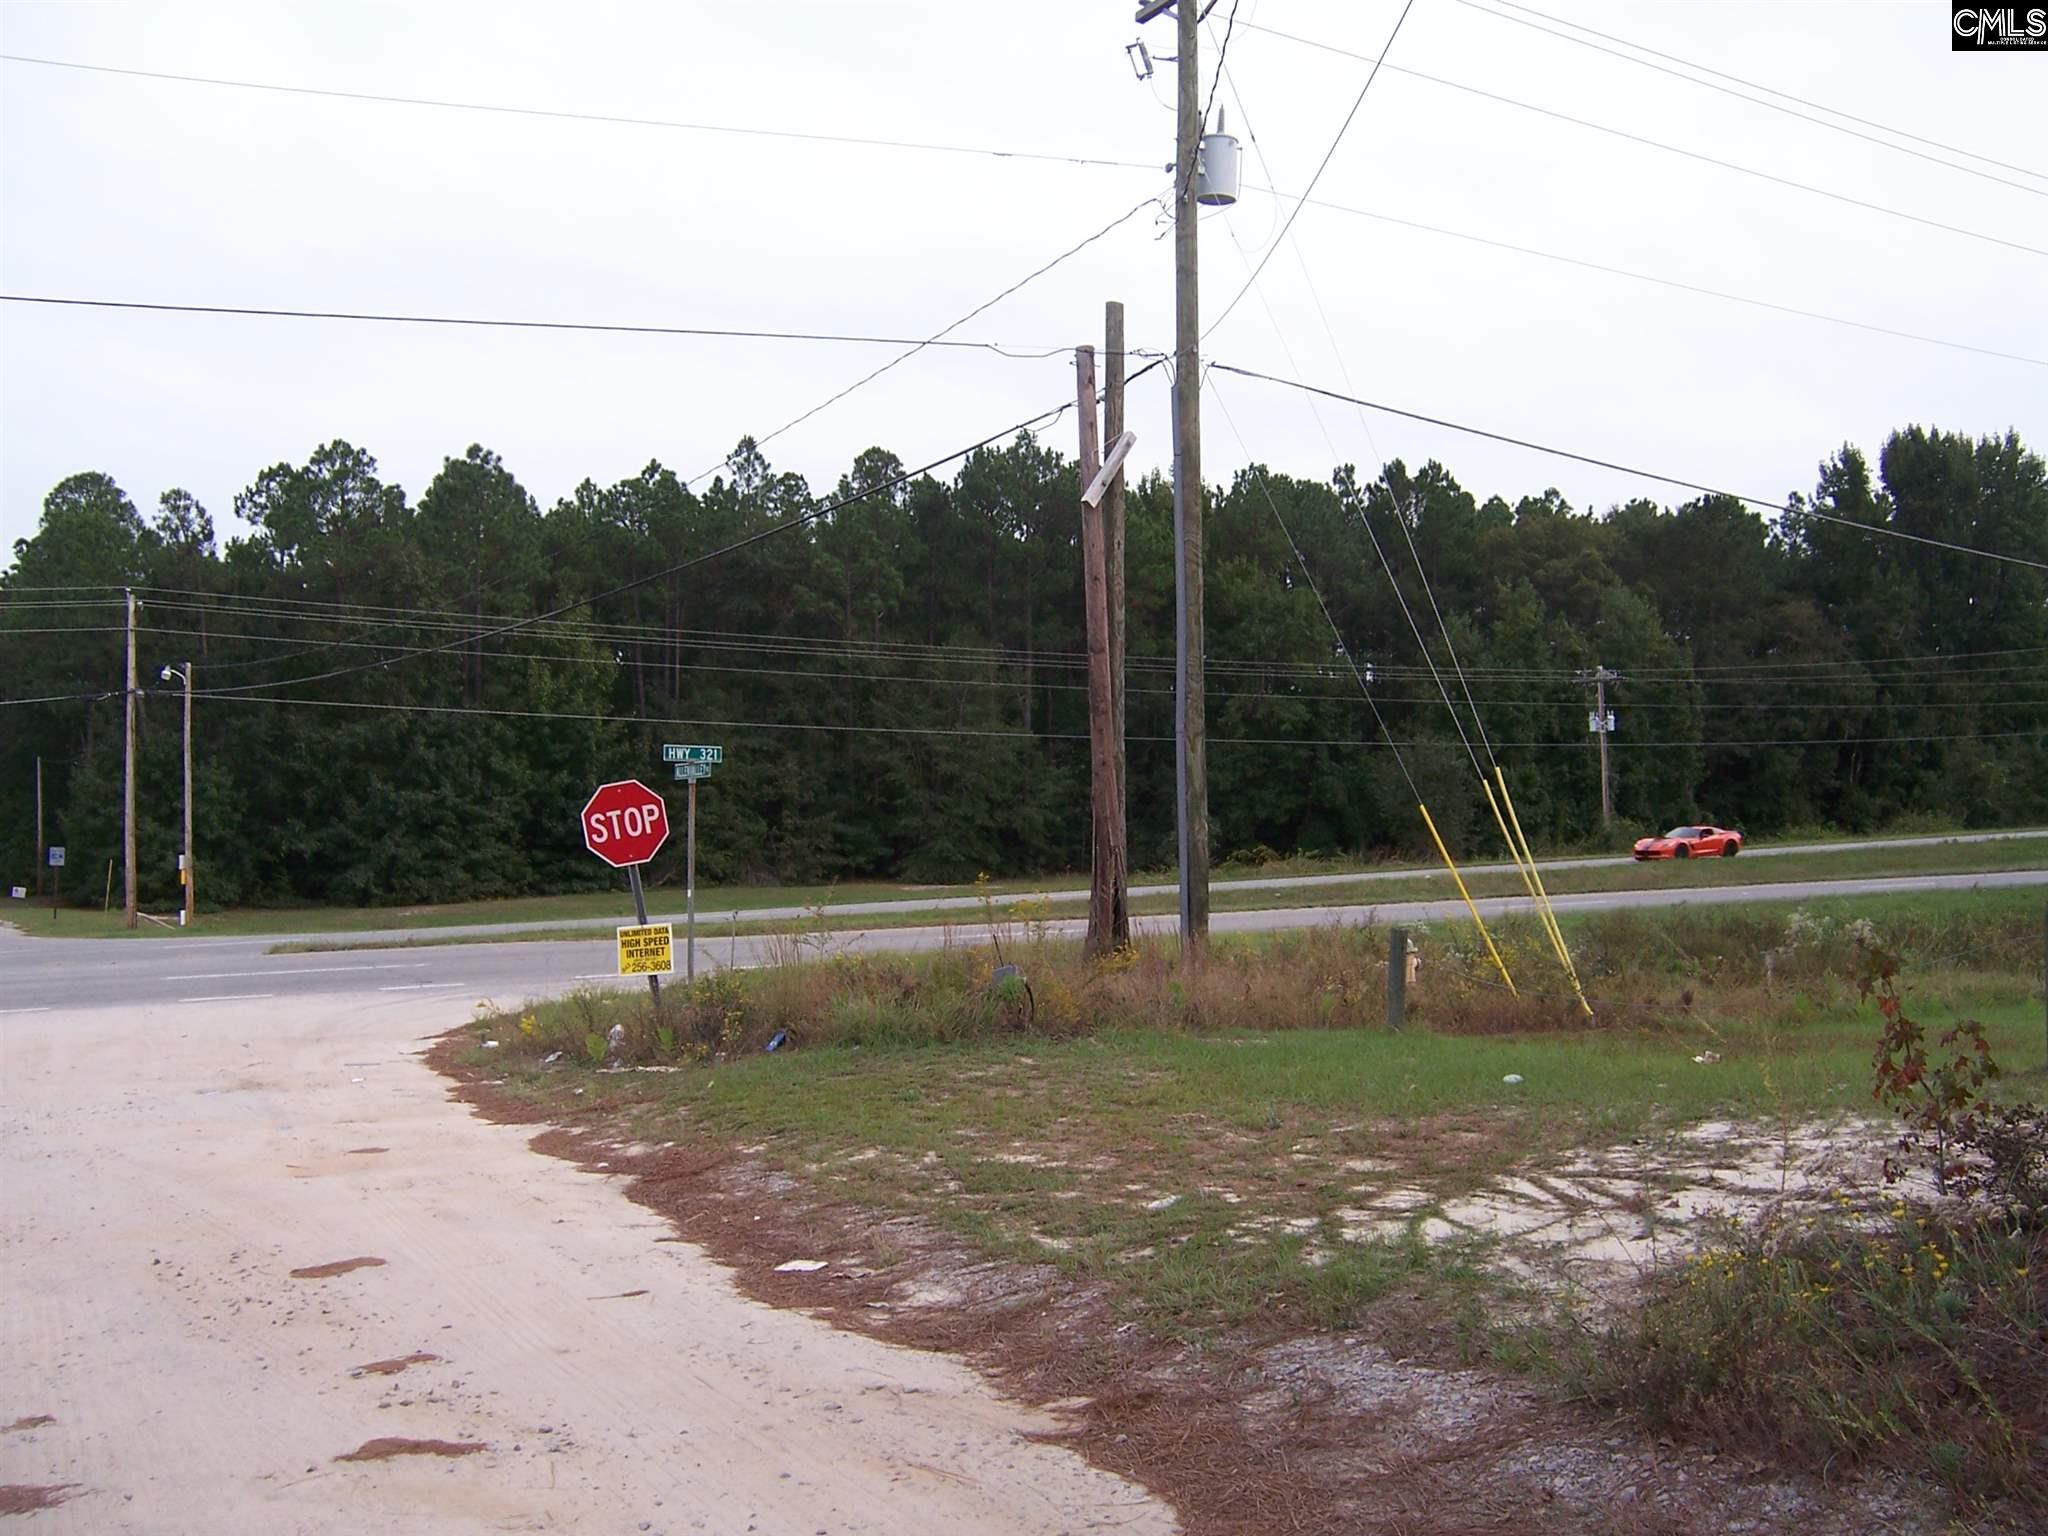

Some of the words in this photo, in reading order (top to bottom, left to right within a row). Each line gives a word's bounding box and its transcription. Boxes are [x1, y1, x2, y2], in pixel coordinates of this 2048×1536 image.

[668, 747, 690, 760] HWY
[699, 748, 718, 761] 321
[590, 803, 660, 844] STOP
[620, 929, 652, 937] UNLIMITED
[621, 938, 641, 948] HIGH
[643, 936, 669, 947] SPEED
[626, 947, 665, 958] INTERNET
